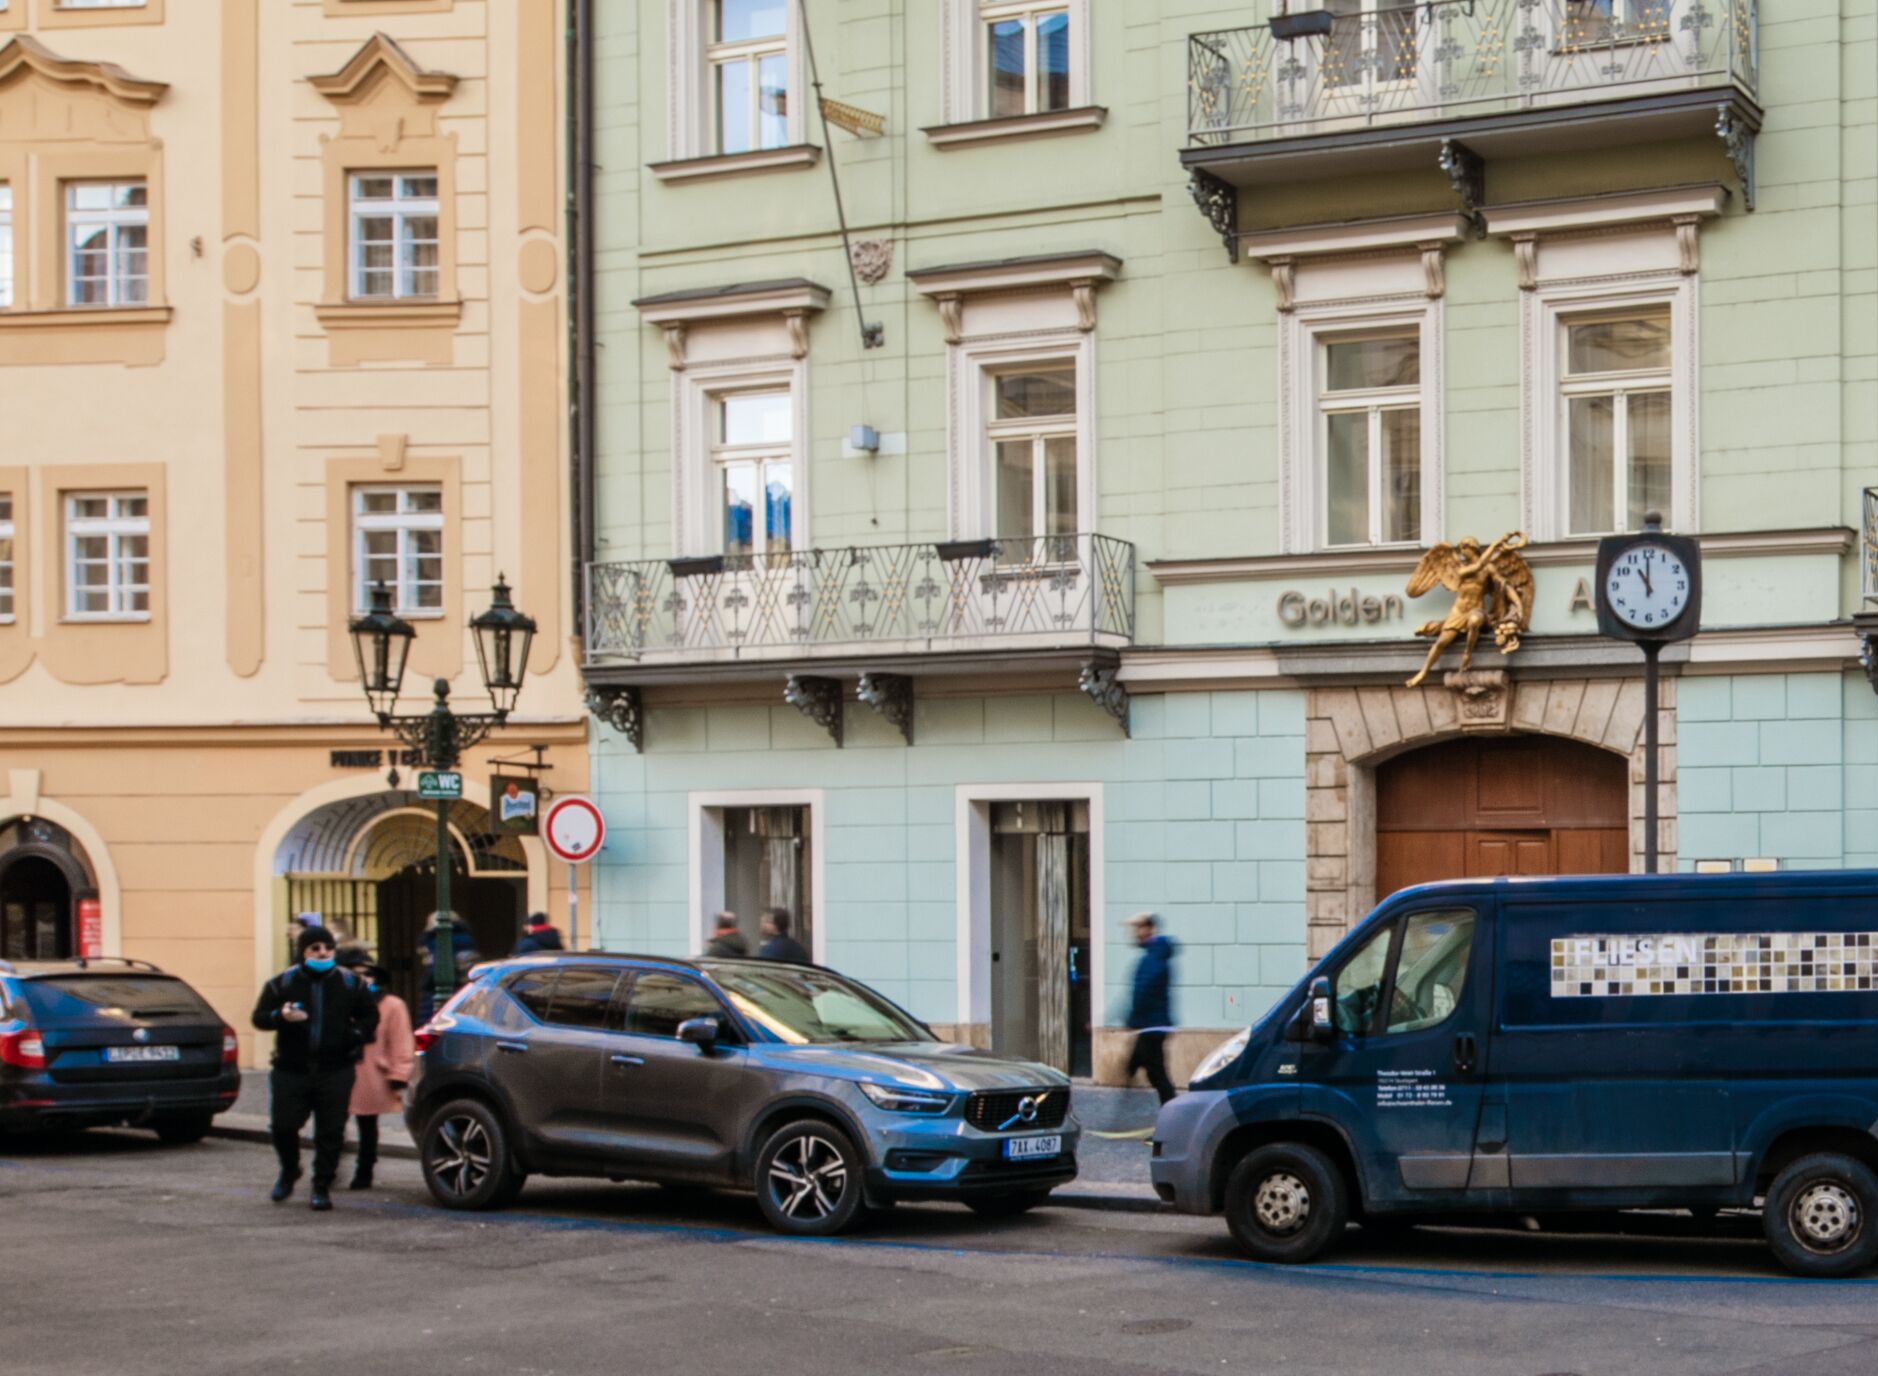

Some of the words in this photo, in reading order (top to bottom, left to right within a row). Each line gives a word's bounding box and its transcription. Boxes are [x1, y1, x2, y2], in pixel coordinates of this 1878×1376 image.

[1627, 554, 1637, 564] 11
[1643, 549, 1655, 559] 12
[1661, 553, 1666, 563] 1
[1616, 566, 1630, 576] 10
[1672, 564, 1680, 574] 2
[1611, 581, 1619, 591] 9
[1677, 580, 1685, 590] 3
[1617, 598, 1625, 606] 8
[1671, 596, 1678, 606] 4
[1277, 588, 1403, 628] Golden
[1660, 608, 1668, 618] 5
[1629, 608, 1636, 619] 7
[1645, 612, 1653, 623] 6
[438, 774, 459, 789] WC
[1574, 936, 1697, 965] FLIESEN
